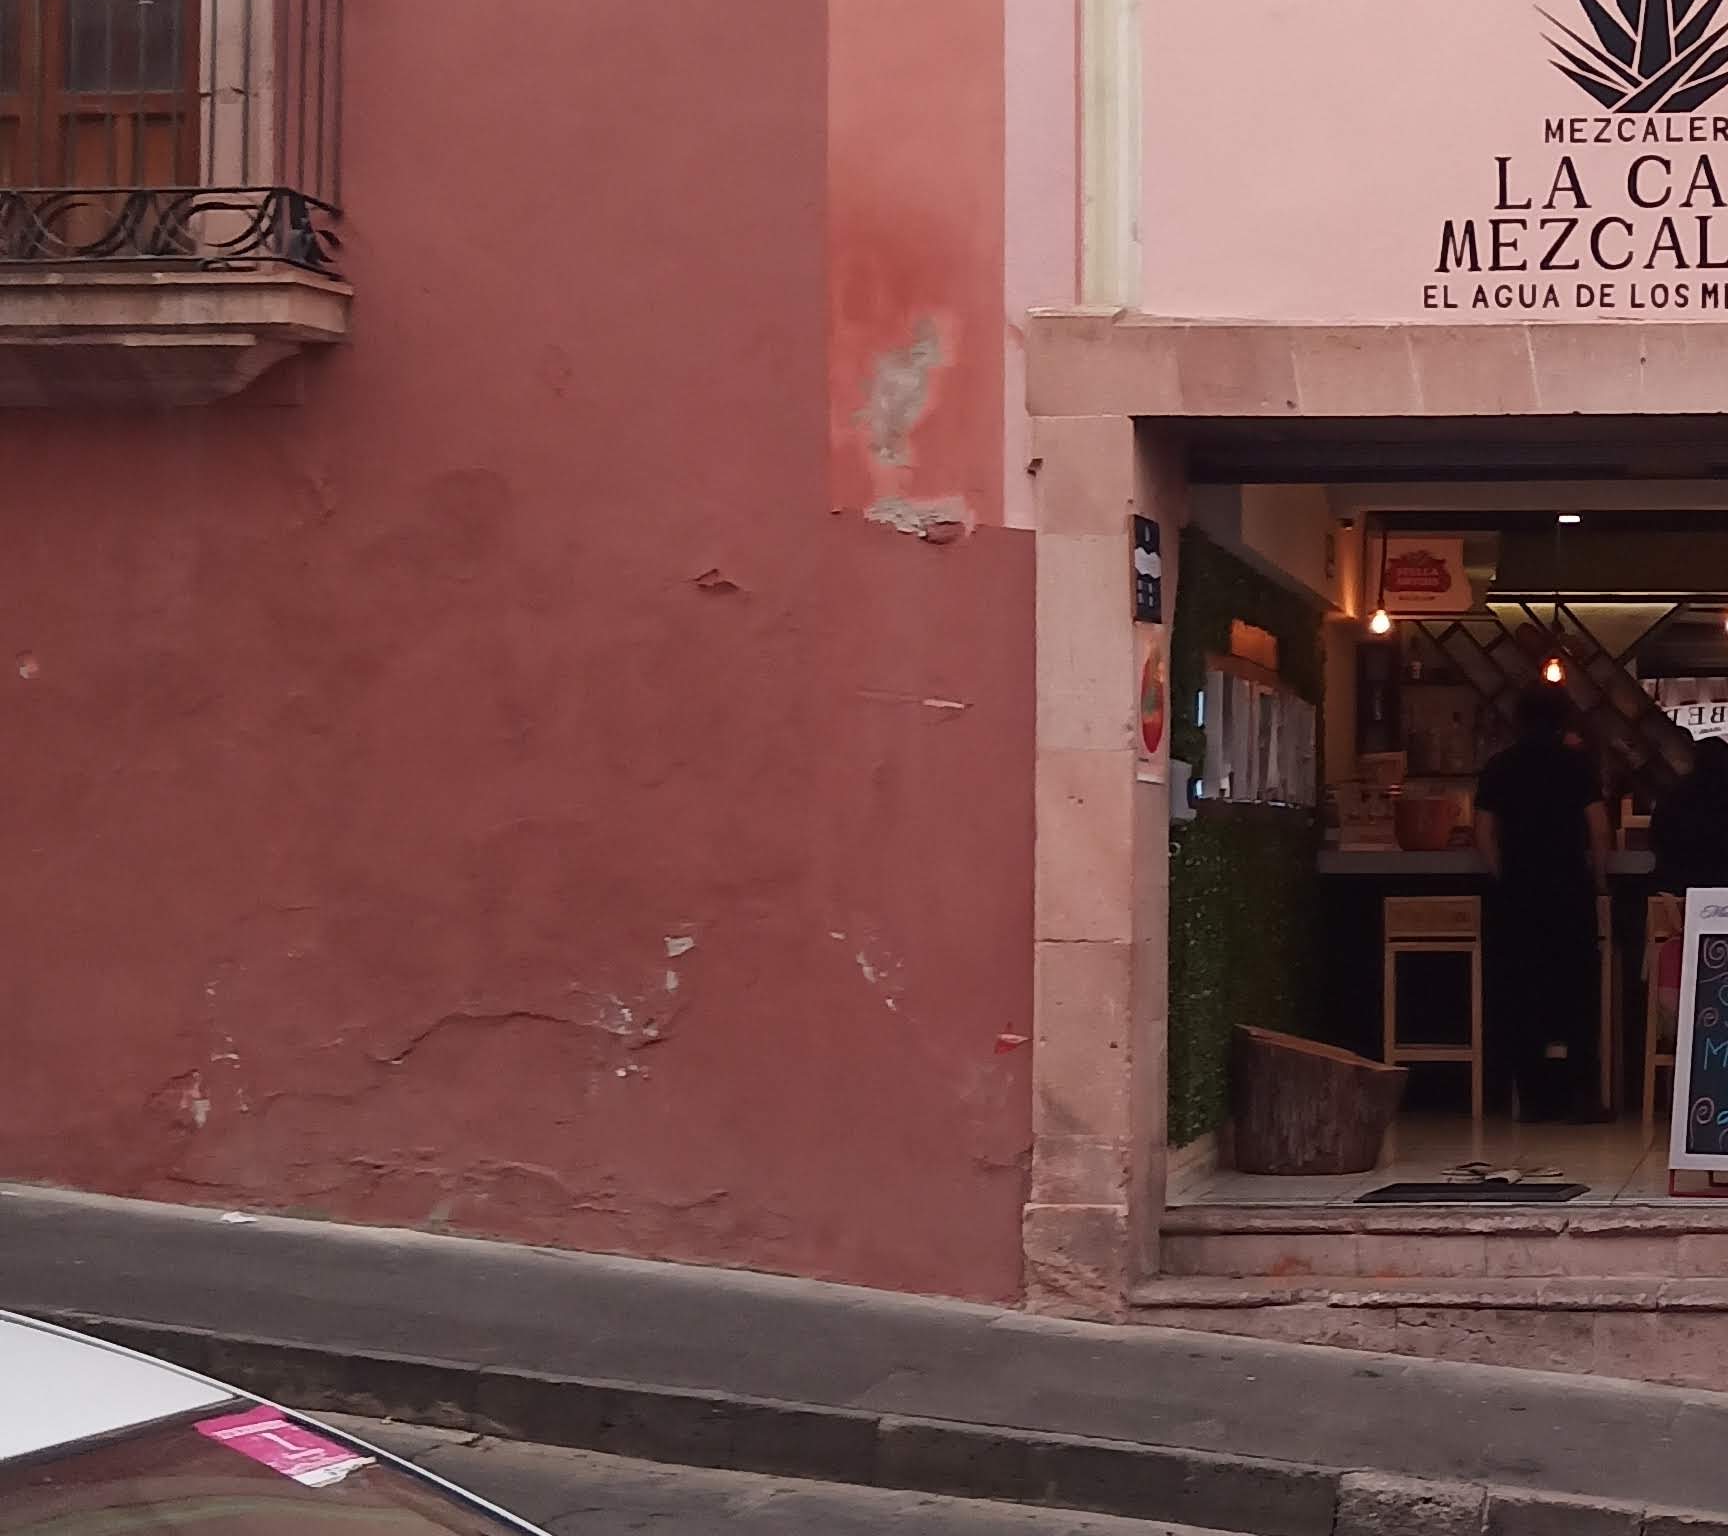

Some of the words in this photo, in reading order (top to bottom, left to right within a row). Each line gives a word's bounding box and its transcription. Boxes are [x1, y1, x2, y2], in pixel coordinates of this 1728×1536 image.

[1494, 155, 1592, 210] LA
[1423, 284, 1458, 309] EL
[1472, 283, 1560, 309] AGUA
[1576, 283, 1616, 308] DE
[1630, 283, 1690, 309] LOS
